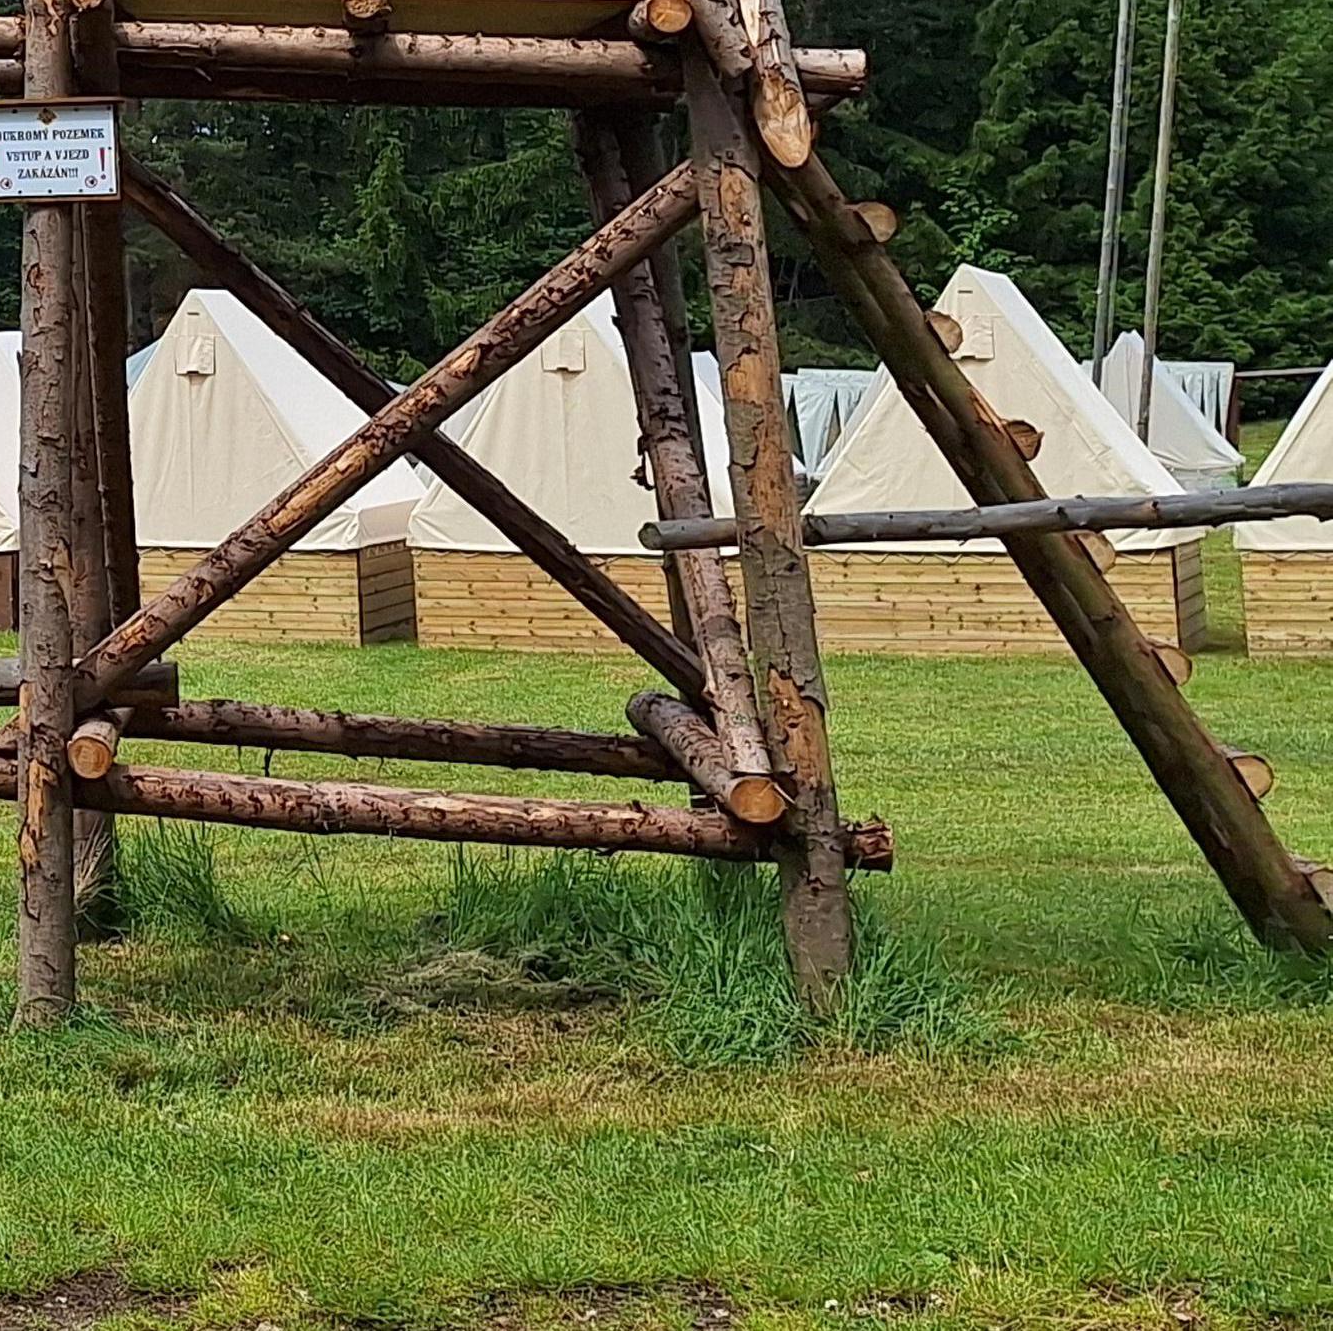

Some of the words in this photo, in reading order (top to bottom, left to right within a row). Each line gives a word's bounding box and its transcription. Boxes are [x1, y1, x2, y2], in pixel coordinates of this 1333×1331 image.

[52, 128, 105, 140] POZEMEK
[7, 150, 41, 161] VSTUP
[45, 151, 52, 160] A
[55, 149, 89, 160] VJEZD
[18, 165, 78, 179] ZAKÁZÁN!!!
